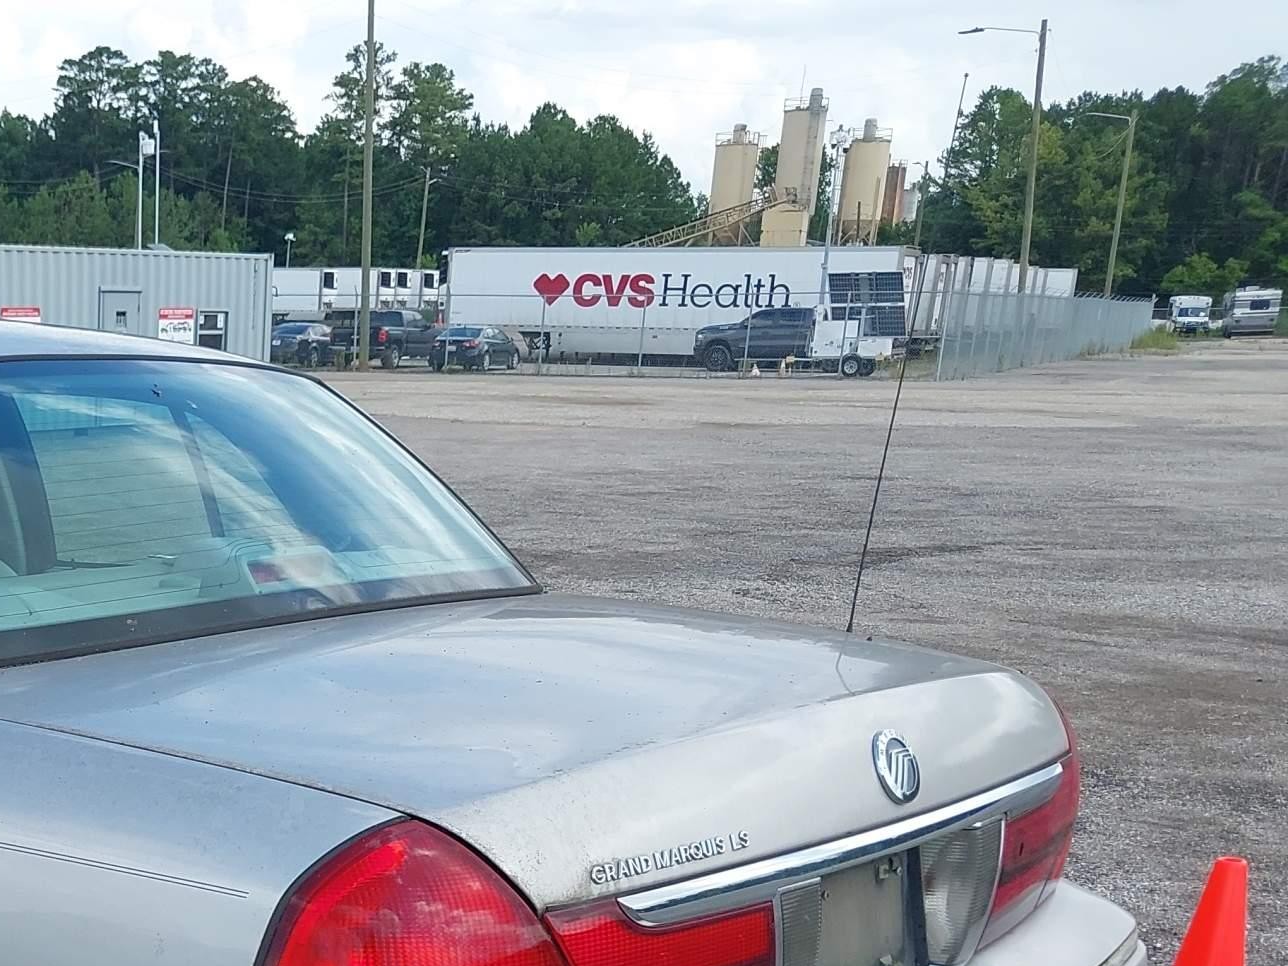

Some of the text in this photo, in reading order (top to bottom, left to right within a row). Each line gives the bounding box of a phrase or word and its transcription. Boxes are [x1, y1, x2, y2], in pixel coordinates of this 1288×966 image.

[573, 273, 791, 308] CVS Health
[591, 830, 750, 884] GRAND MARQUIS LS
